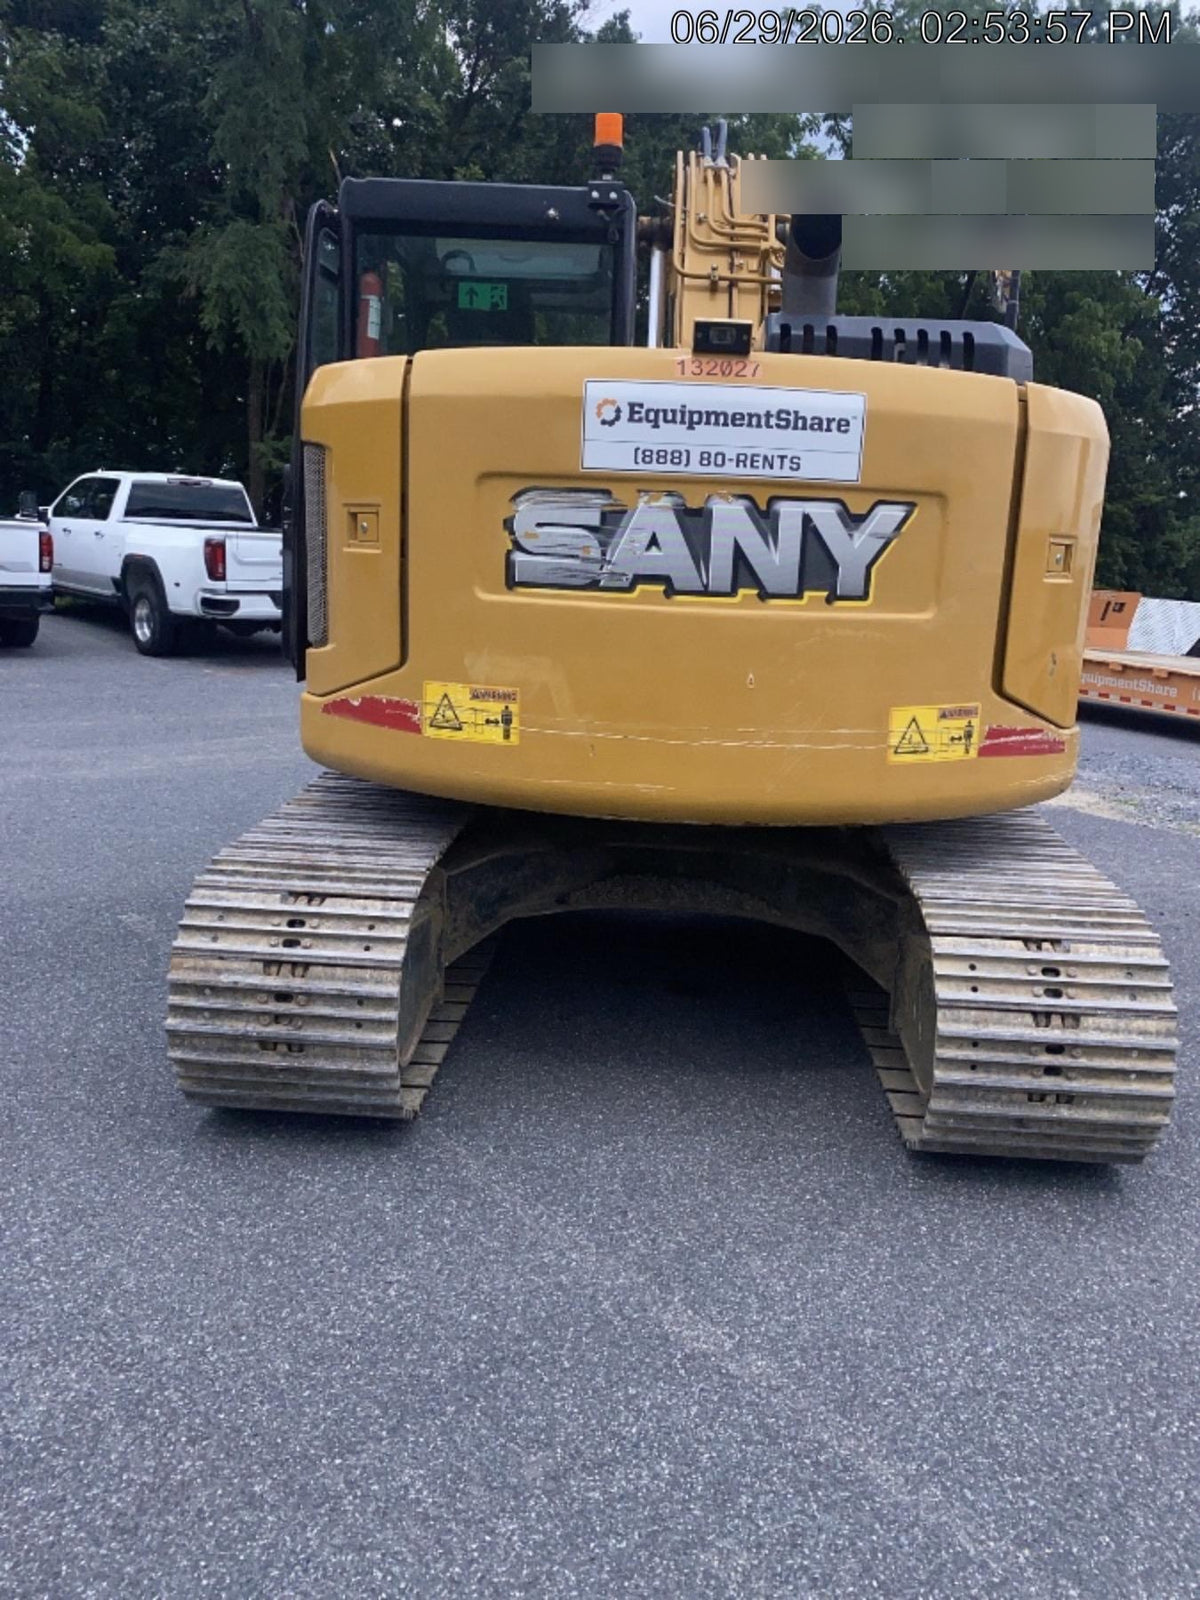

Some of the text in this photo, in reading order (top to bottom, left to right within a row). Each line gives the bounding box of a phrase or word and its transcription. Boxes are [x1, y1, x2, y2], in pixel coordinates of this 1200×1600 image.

[626, 401, 851, 434] EquipmentShare
[633, 446, 802, 472] (888) 80-RENTS
[506, 486, 915, 604] SANY
